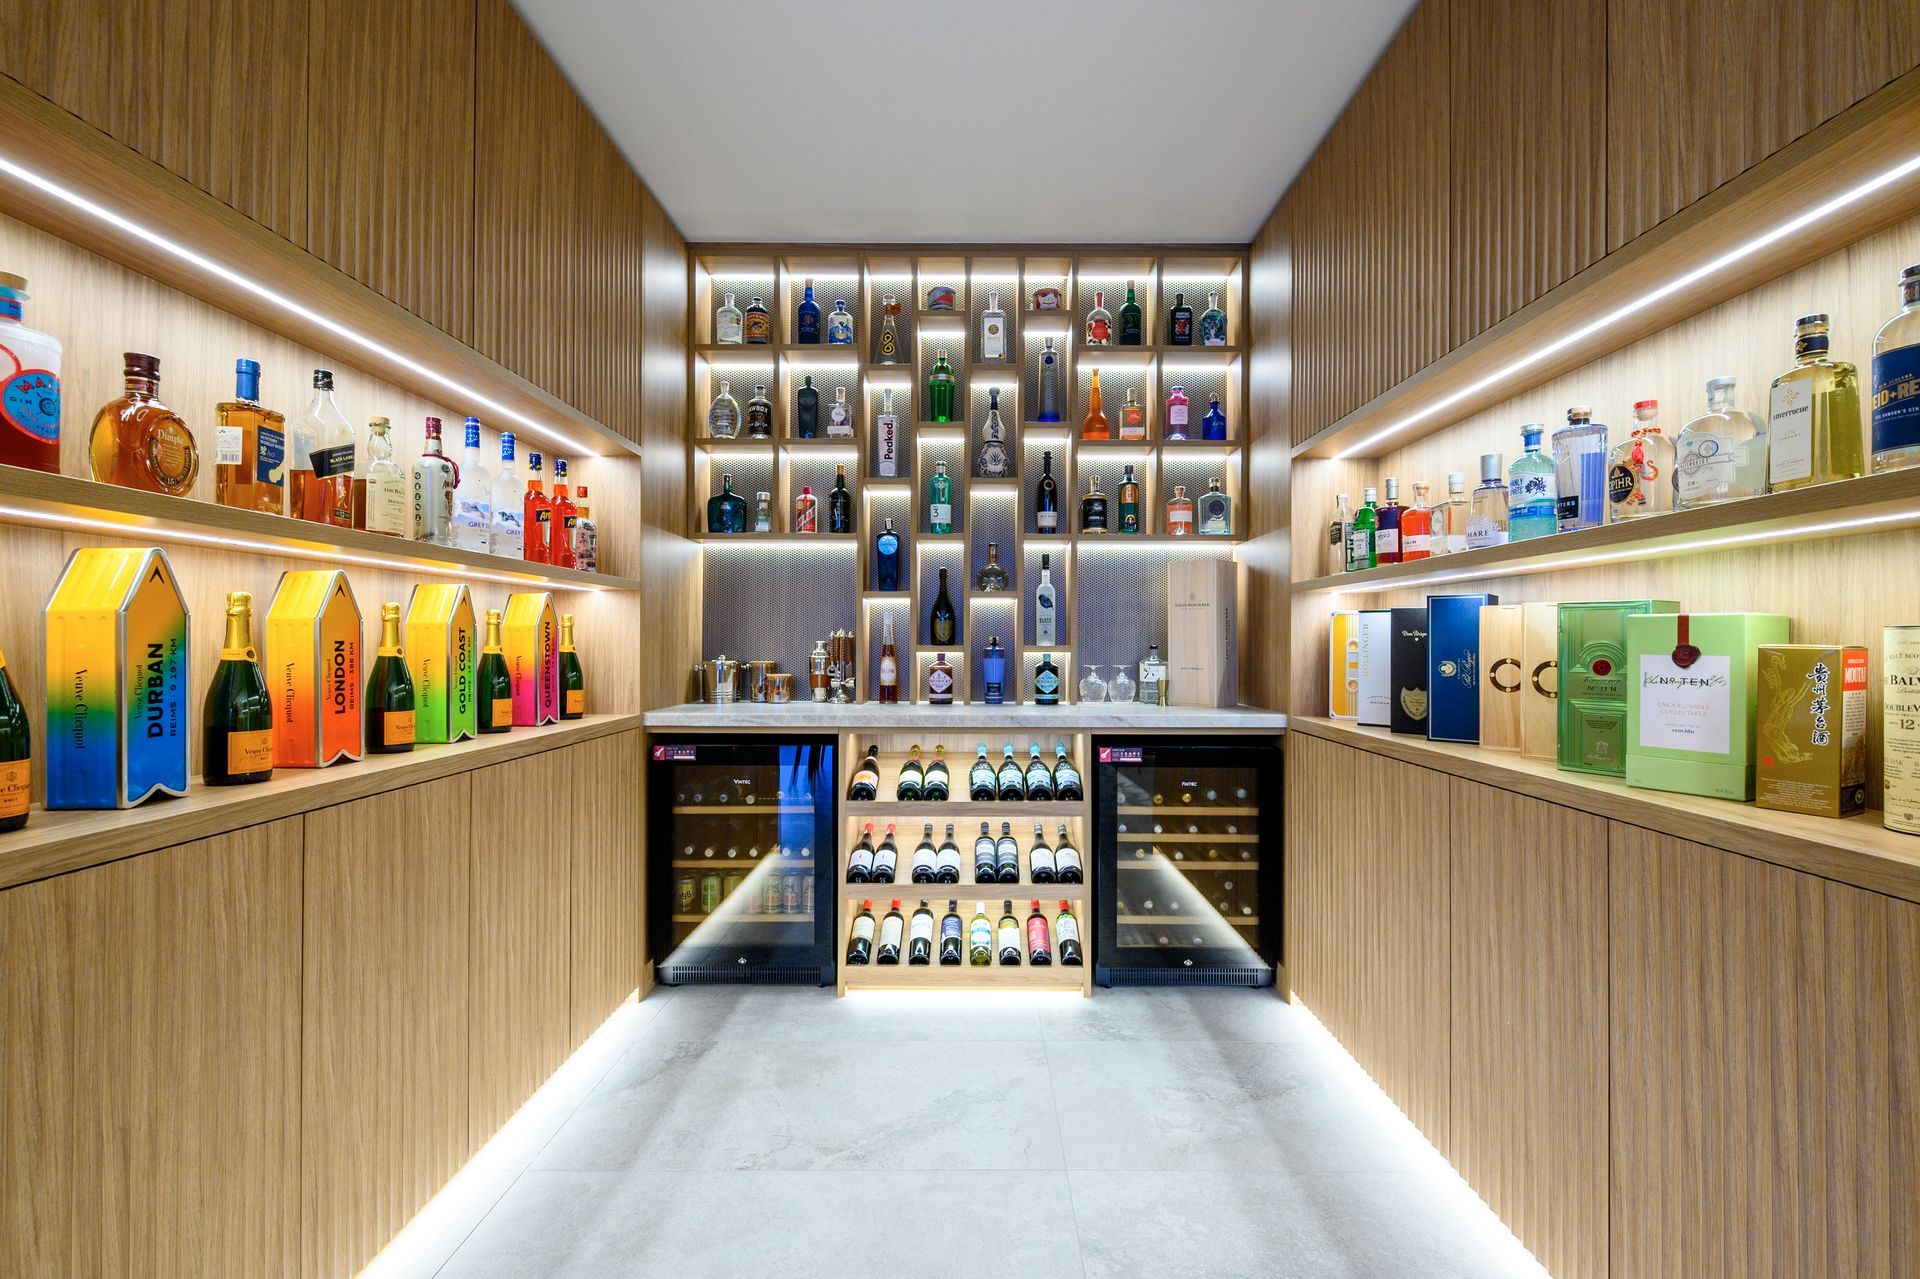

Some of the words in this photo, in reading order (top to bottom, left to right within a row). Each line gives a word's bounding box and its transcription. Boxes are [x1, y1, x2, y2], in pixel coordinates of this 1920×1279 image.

[9, 396, 32, 405] GIN
[157, 428, 185, 446] Dimple
[468, 521, 486, 529] GREY
[1467, 529, 1491, 538] MARE
[169, 638, 176, 656] KM
[349, 642, 355, 656] KM
[458, 626, 467, 672] COAST
[286, 662, 295, 687] Veuve
[423, 658, 431, 680] Veuve
[544, 621, 552, 709] QUEENSTOWN
[75, 668, 88, 701] Veuve
[334, 640, 346, 715] LONDON
[1679, 677, 1709, 687] TEN
[147, 643, 163, 738] DURBAN
[458, 675, 467, 714] GOLD
[285, 688, 295, 723] Clicquot
[72, 703, 88, 749] Clicquot
[1899, 717, 1915, 731] 12
